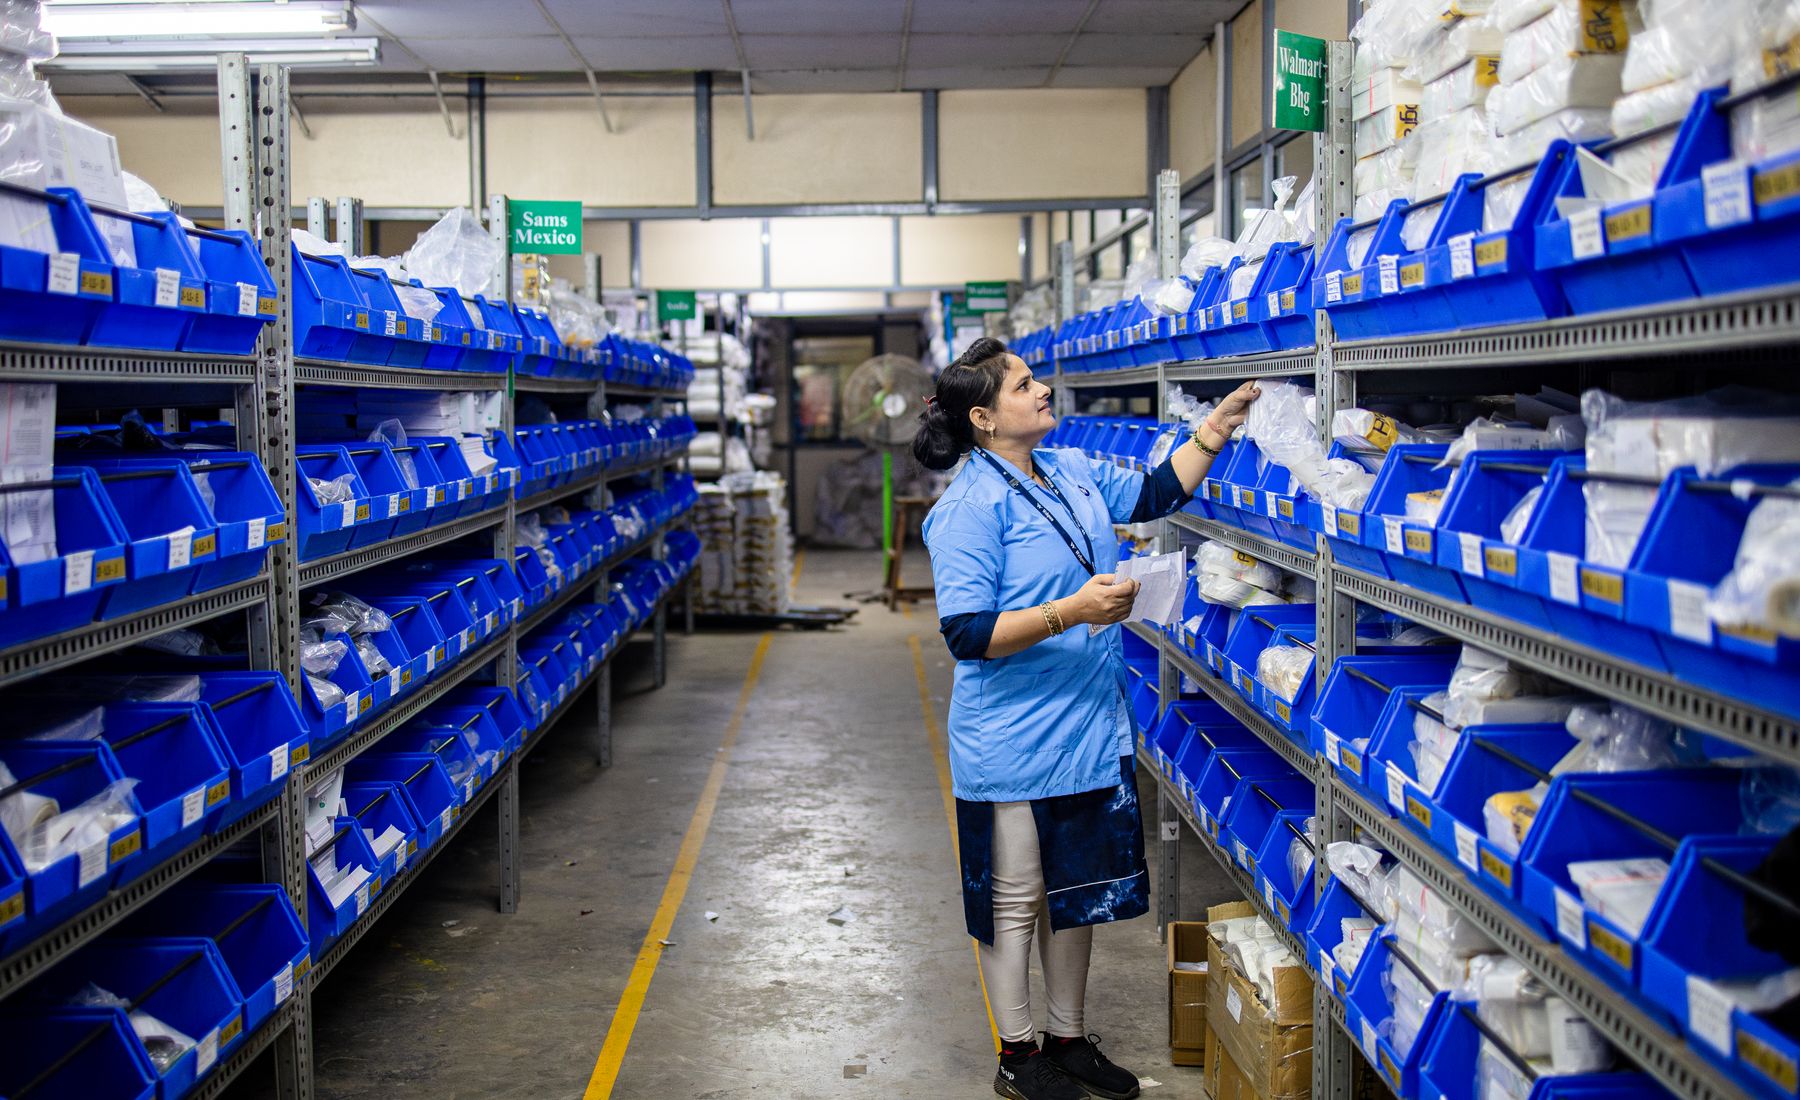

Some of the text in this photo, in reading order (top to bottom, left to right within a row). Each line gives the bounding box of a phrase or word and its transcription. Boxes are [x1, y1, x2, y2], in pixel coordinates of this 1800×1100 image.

[1280, 46, 1322, 79] Walmart
[1290, 82, 1310, 116] Bhg
[522, 211, 568, 227] Sams
[515, 228, 577, 245] Mexico
